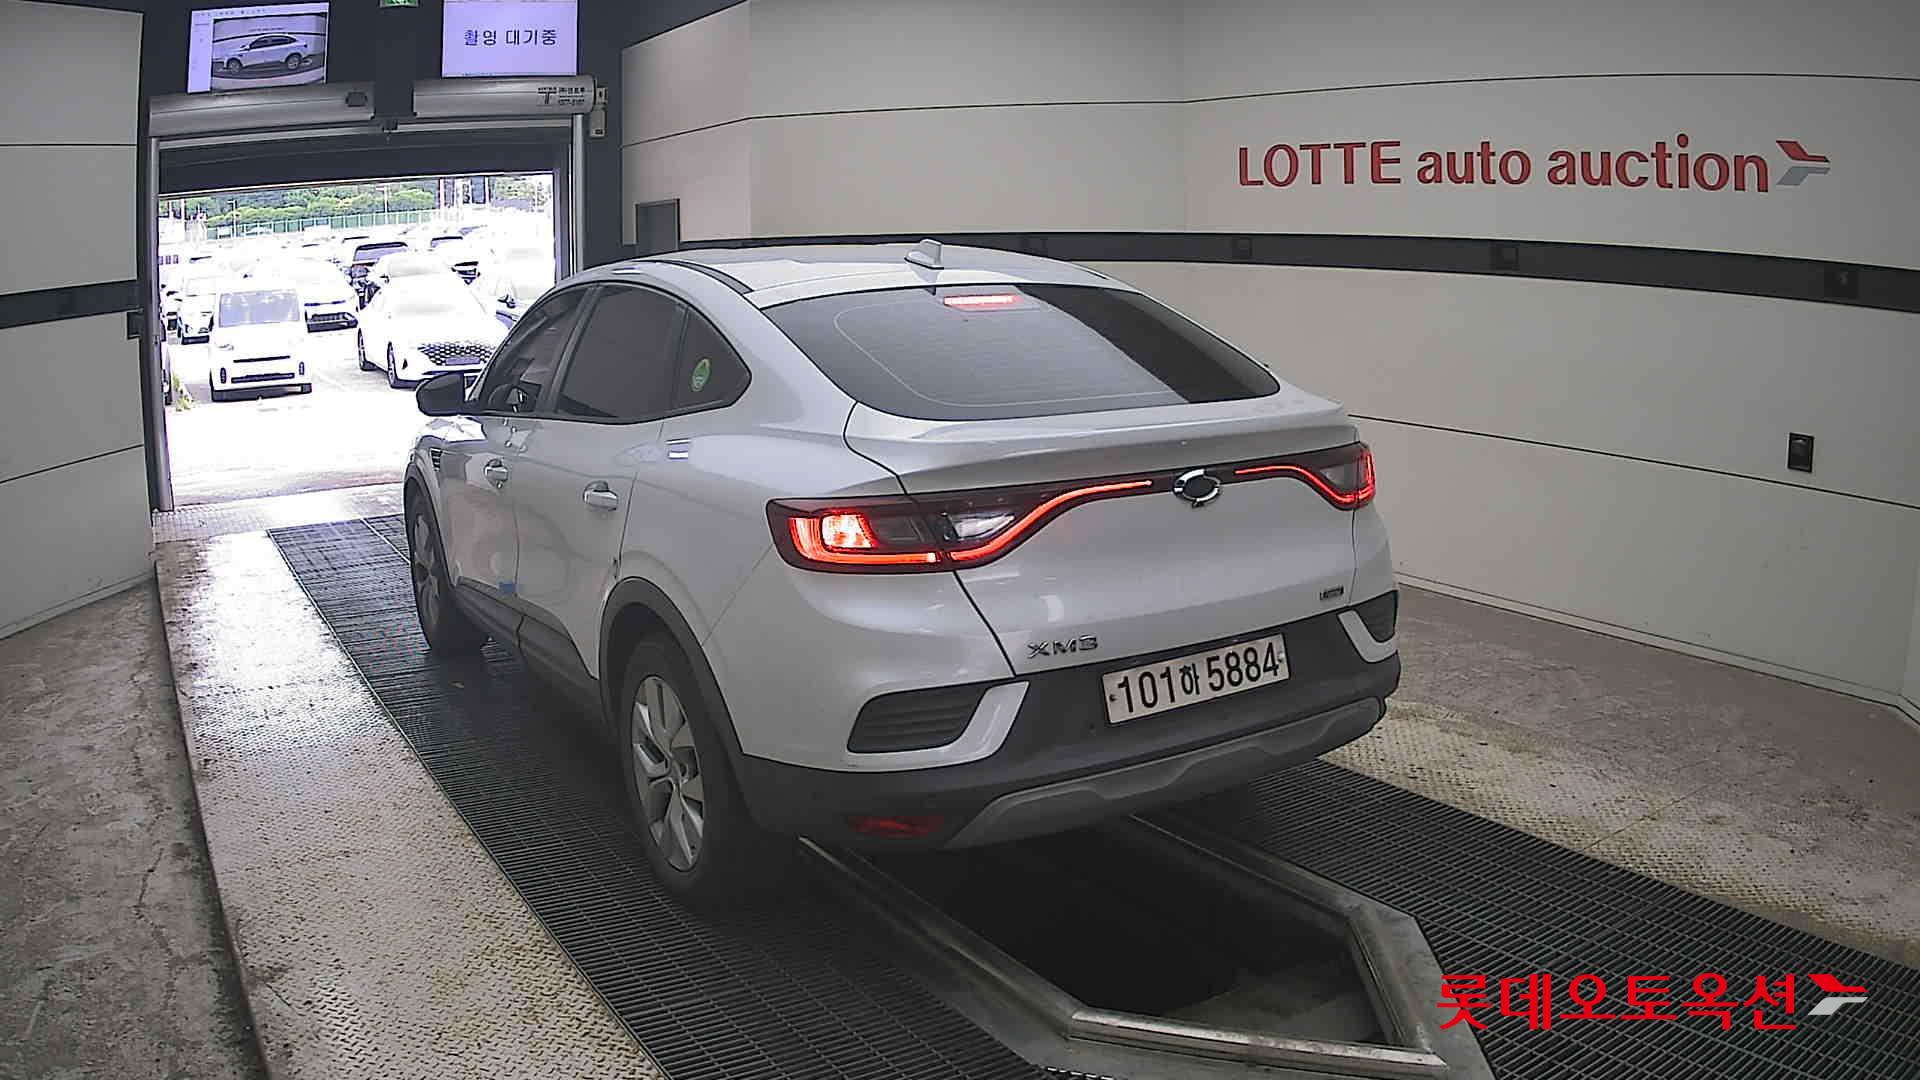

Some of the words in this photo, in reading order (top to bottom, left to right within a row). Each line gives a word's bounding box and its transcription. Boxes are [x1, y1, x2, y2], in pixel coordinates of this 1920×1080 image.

[505, 29, 557, 46] 대기중
[1238, 140, 1401, 187] LOTTE
[1416, 141, 1532, 185] auto
[1546, 133, 1769, 193] auction
